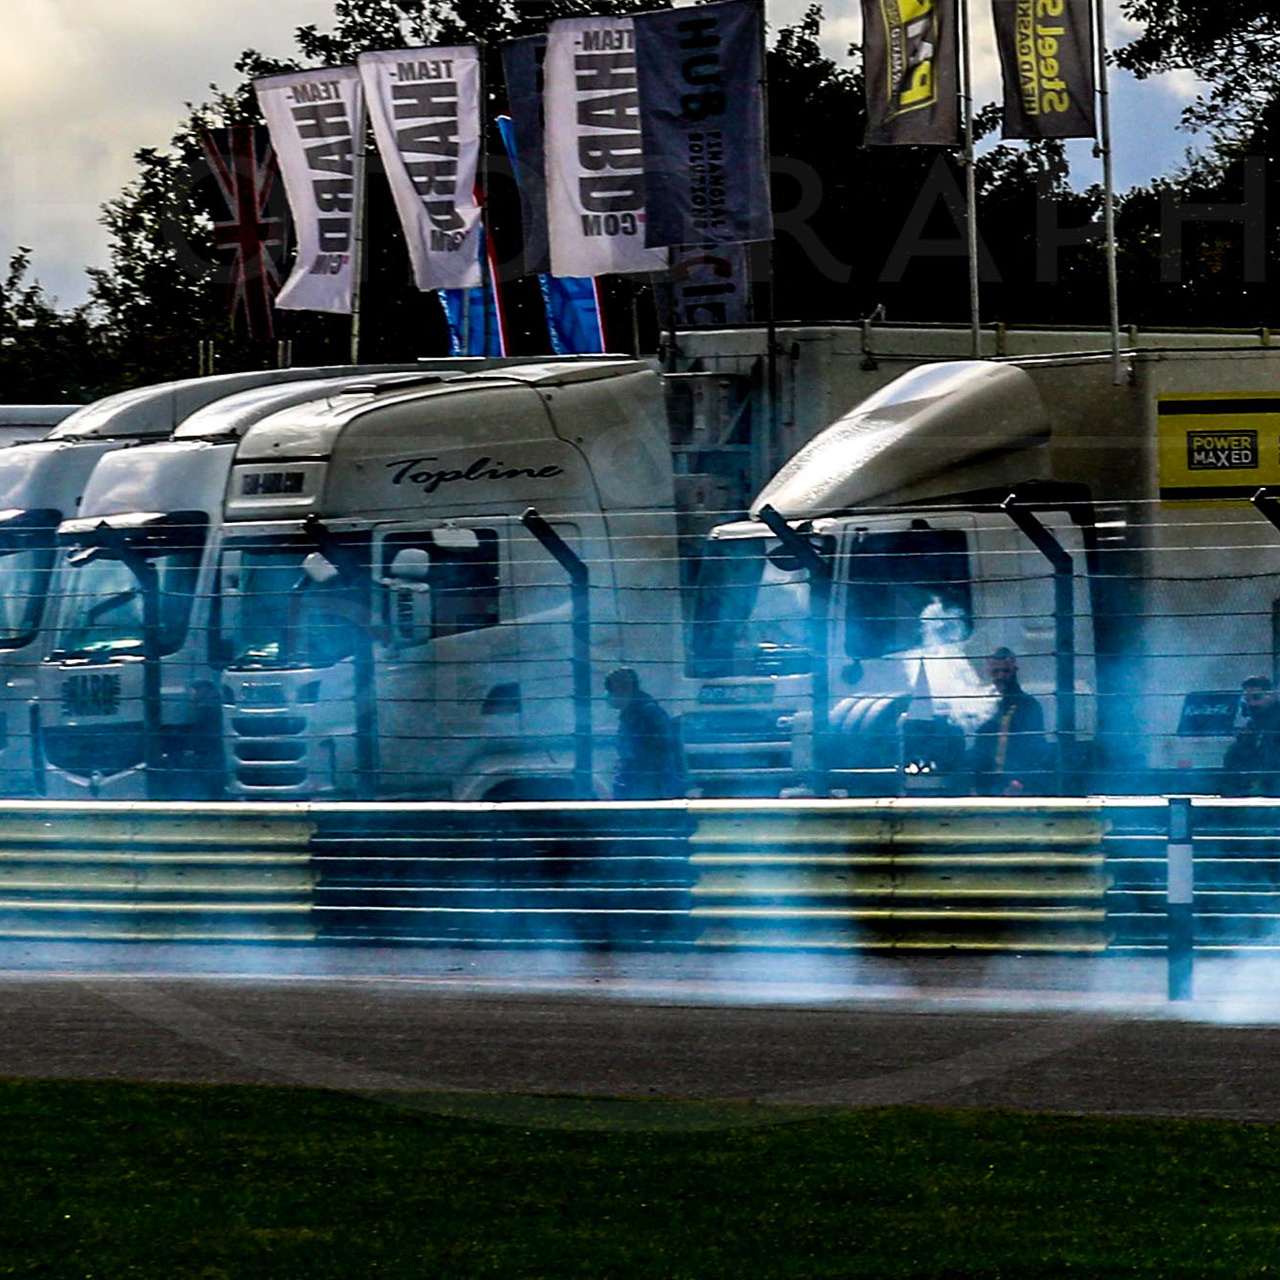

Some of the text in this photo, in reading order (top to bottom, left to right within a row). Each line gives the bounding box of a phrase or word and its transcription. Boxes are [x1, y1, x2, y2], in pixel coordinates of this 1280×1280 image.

[677, 17, 726, 122] HUB
[689, 133, 708, 229] SOLUTIONS
[706, 131, 726, 229] FINANCIAL
[385, 455, 566, 493] Topline
[1193, 436, 1251, 450] POWER
[1193, 450, 1252, 467] MAXED
